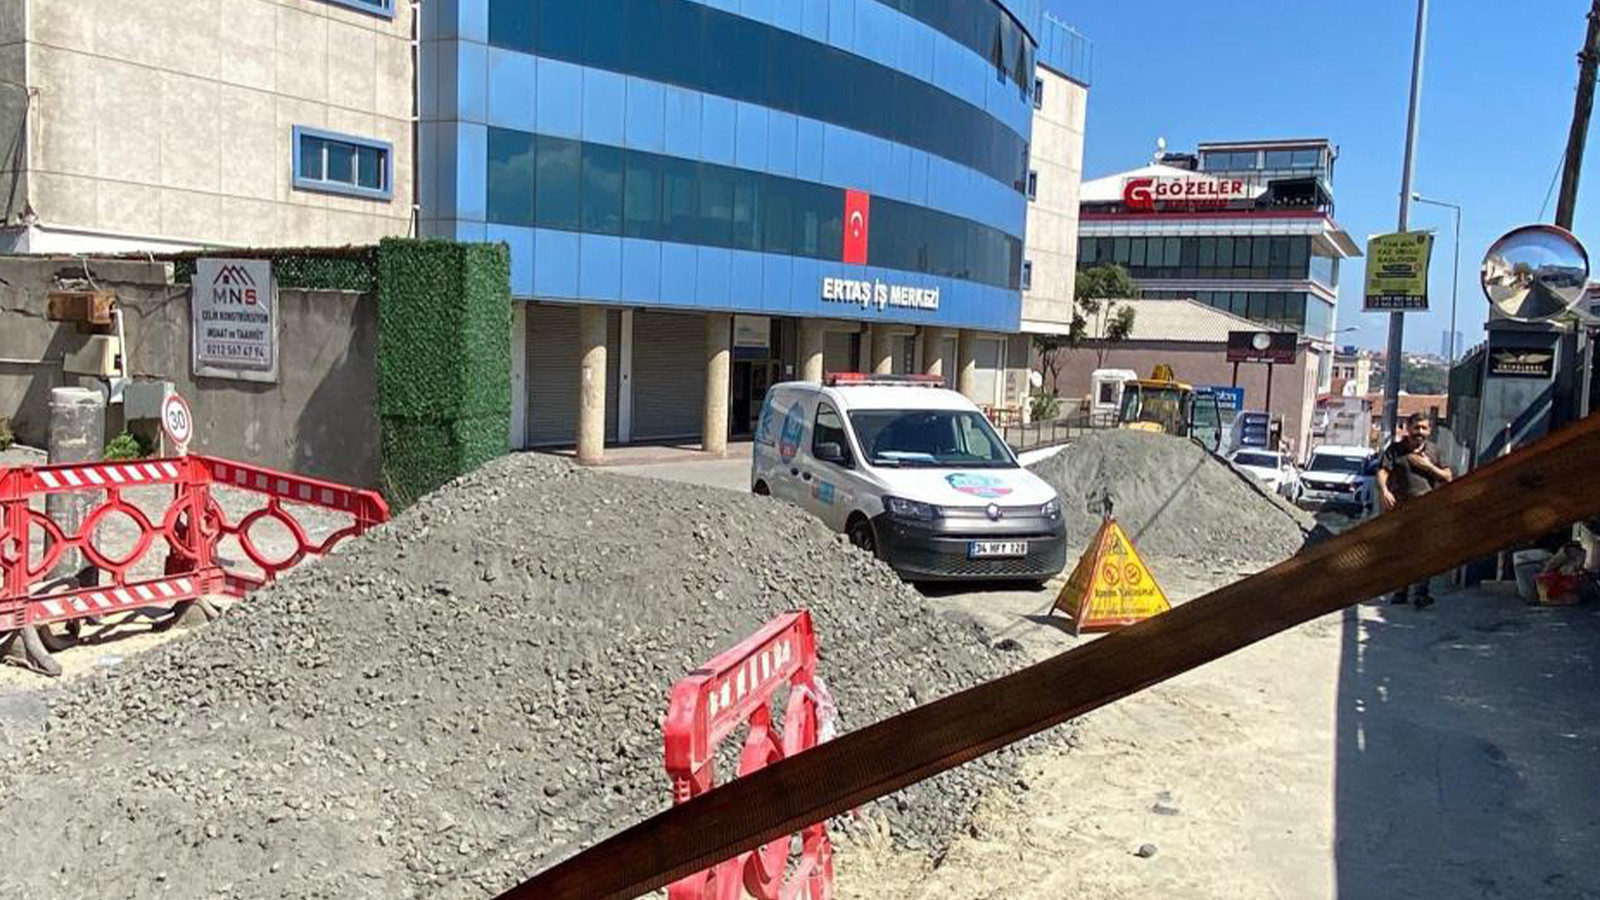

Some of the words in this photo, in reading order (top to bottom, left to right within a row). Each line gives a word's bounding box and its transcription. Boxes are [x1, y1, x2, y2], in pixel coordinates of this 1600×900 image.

[1156, 178, 1243, 196] GÖZELER
[213, 287, 257, 305] MNS
[823, 277, 871, 308] ERTAŞ
[874, 277, 888, 310] İŞ
[890, 285, 939, 309] MERKEZİ
[207, 344, 225, 355] 0212
[169, 410, 186, 430] 30
[976, 543, 987, 554] 34
